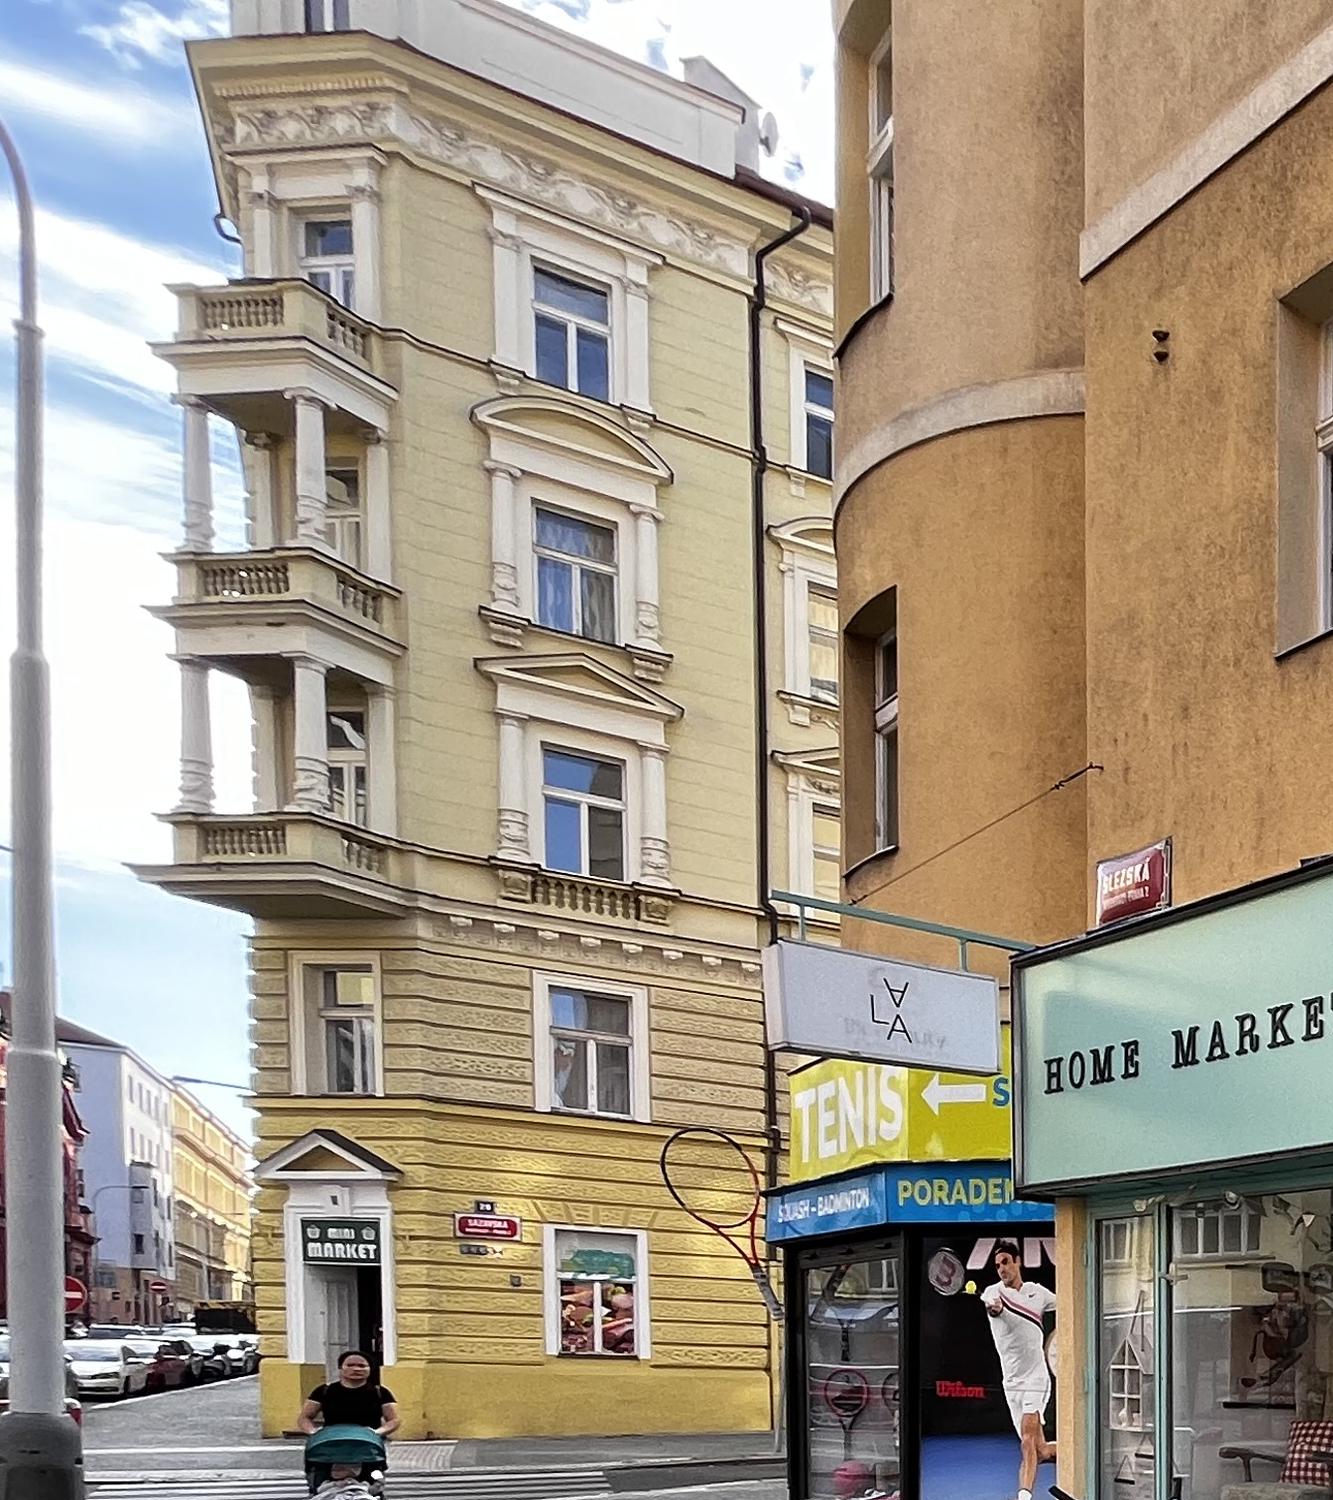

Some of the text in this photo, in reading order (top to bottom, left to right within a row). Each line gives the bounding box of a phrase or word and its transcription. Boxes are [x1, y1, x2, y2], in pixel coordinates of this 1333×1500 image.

[1103, 857, 1150, 894] SLEZSKÁ
[1044, 1040, 1139, 1094] HOME
[794, 1064, 904, 1163] TENIS
[777, 1199, 810, 1223] SQUASH
[817, 1187, 870, 1217] BADMINTON
[307, 1243, 377, 1259] MARKET
[327, 1227, 355, 1239] MINI
[936, 1381, 984, 1397] Wilson
